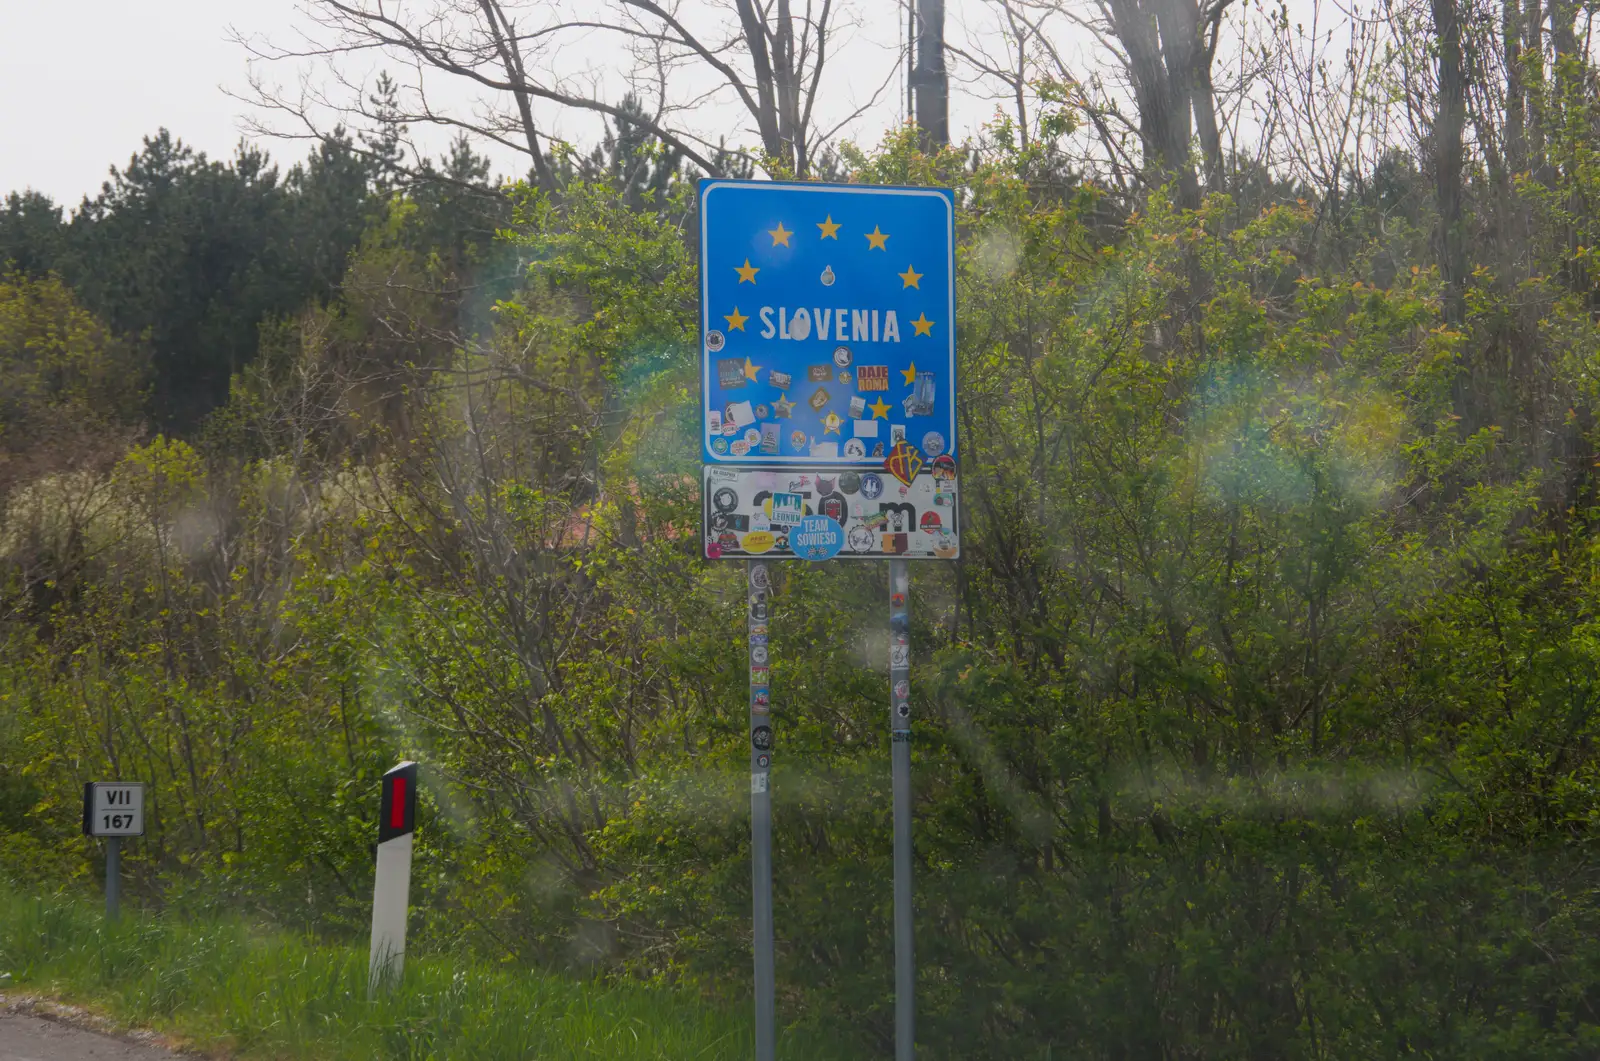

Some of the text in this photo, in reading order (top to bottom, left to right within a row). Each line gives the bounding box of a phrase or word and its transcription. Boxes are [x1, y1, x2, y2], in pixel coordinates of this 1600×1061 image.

[759, 306, 900, 342] SLOVENIA
[858, 378, 889, 391] ROMA
[879, 502, 916, 532] m
[804, 519, 829, 532] TEAM
[797, 532, 837, 546] SOWIESO
[106, 790, 130, 805] VII
[103, 814, 134, 829] 167
